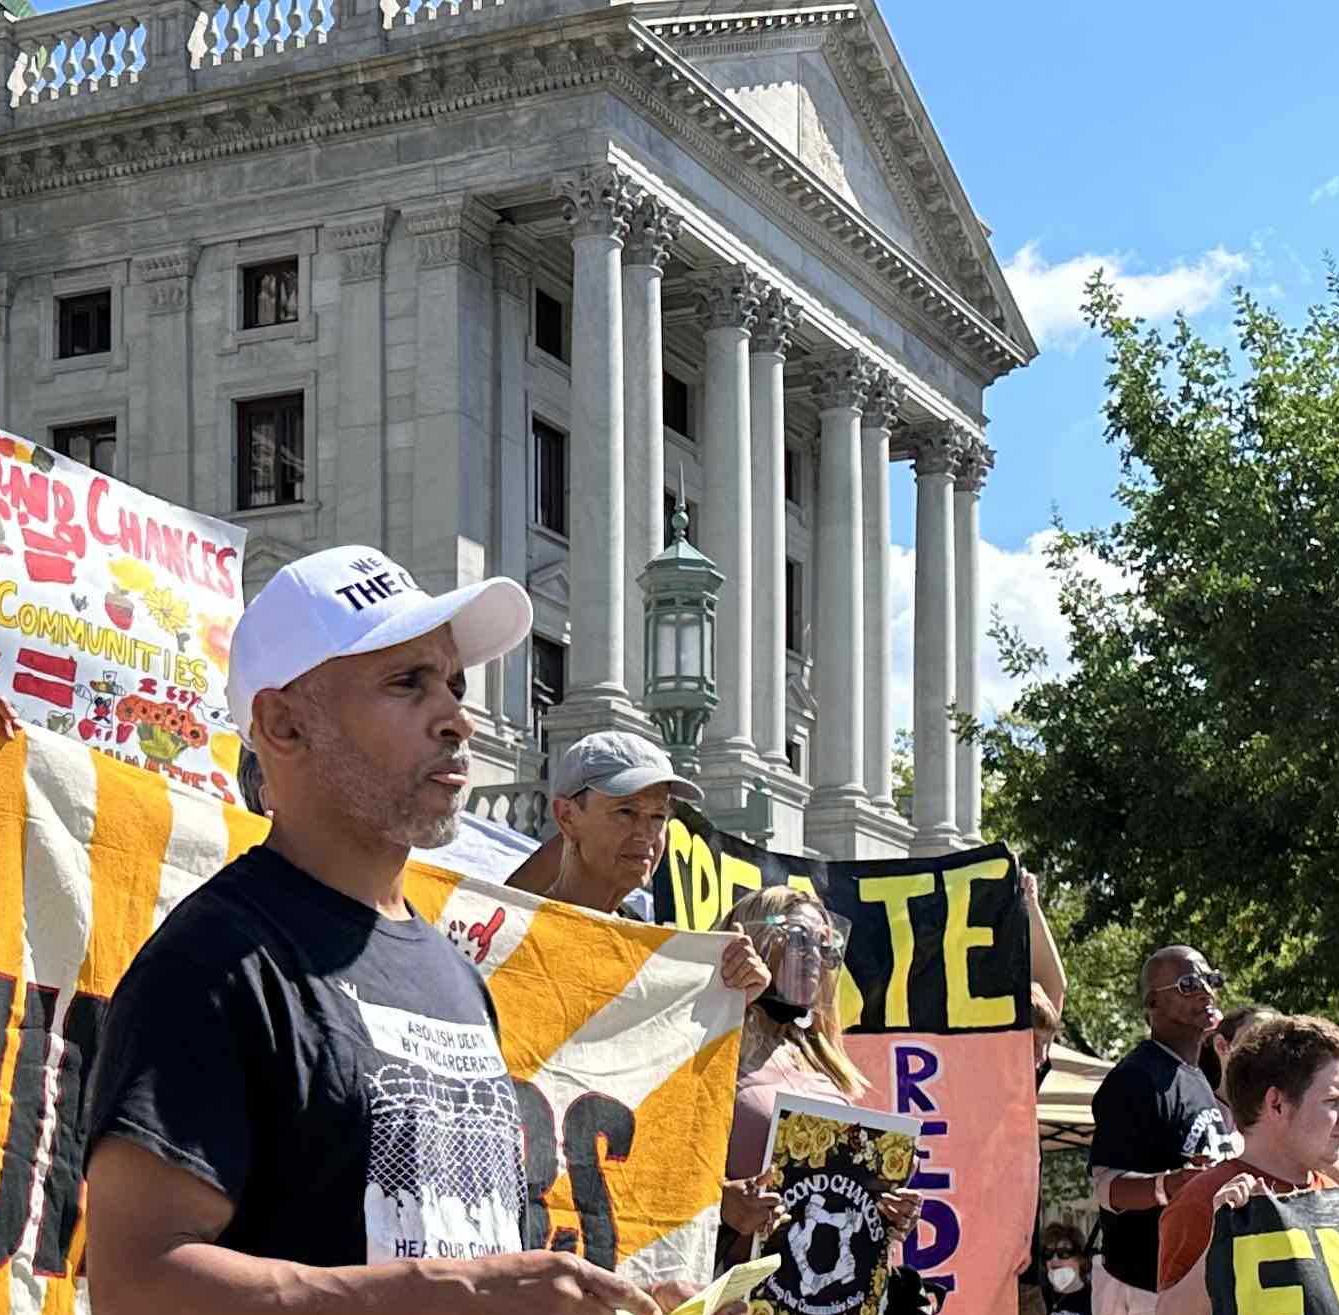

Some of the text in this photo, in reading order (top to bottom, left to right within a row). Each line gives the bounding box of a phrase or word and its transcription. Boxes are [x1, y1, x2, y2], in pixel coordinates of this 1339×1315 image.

[88, 478, 237, 600] CHANCES
[335, 572, 403, 611] THE
[402, 1037, 419, 1055] BY
[783, 1174, 885, 1242] COND CHANCES
